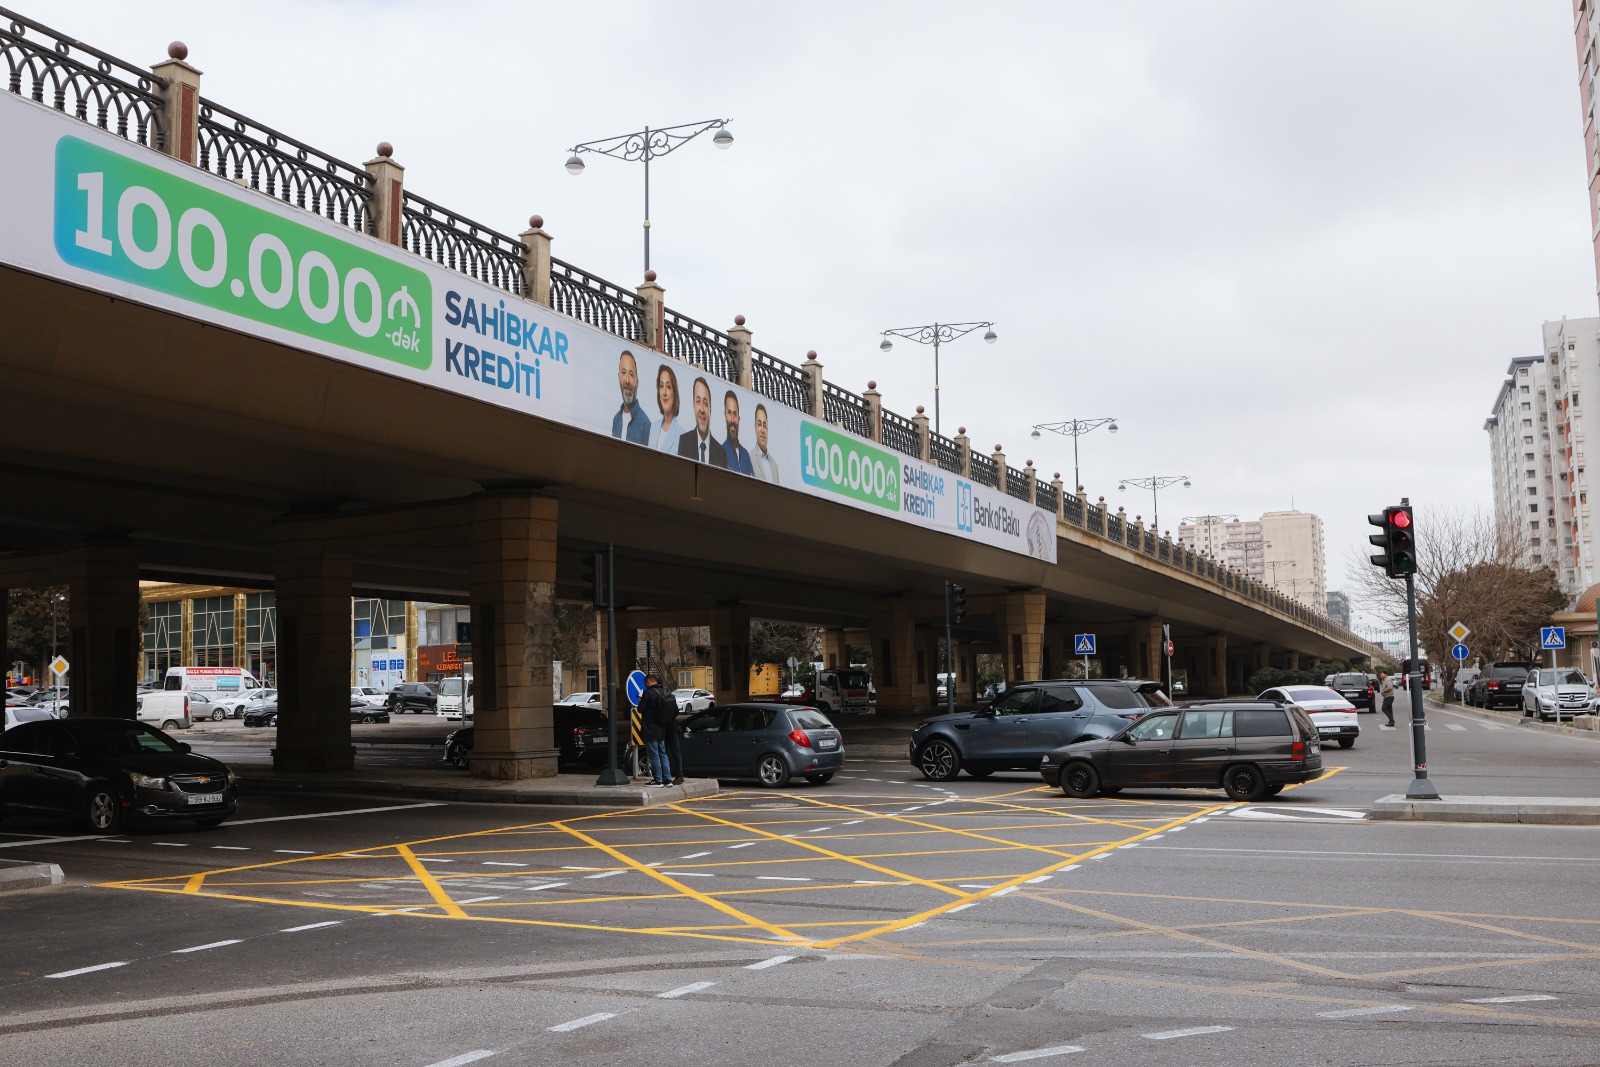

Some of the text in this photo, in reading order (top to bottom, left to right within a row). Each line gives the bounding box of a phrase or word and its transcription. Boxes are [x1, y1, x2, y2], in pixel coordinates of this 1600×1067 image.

[385, 327, 420, 352] -dək
[445, 290, 568, 364] SAHİBKAR
[445, 338, 540, 399] KREDİTİ
[904, 464, 944, 496] SAHİBKAR
[904, 492, 935, 519] KREDİTİ
[974, 497, 1019, 537] Bank of Baku
